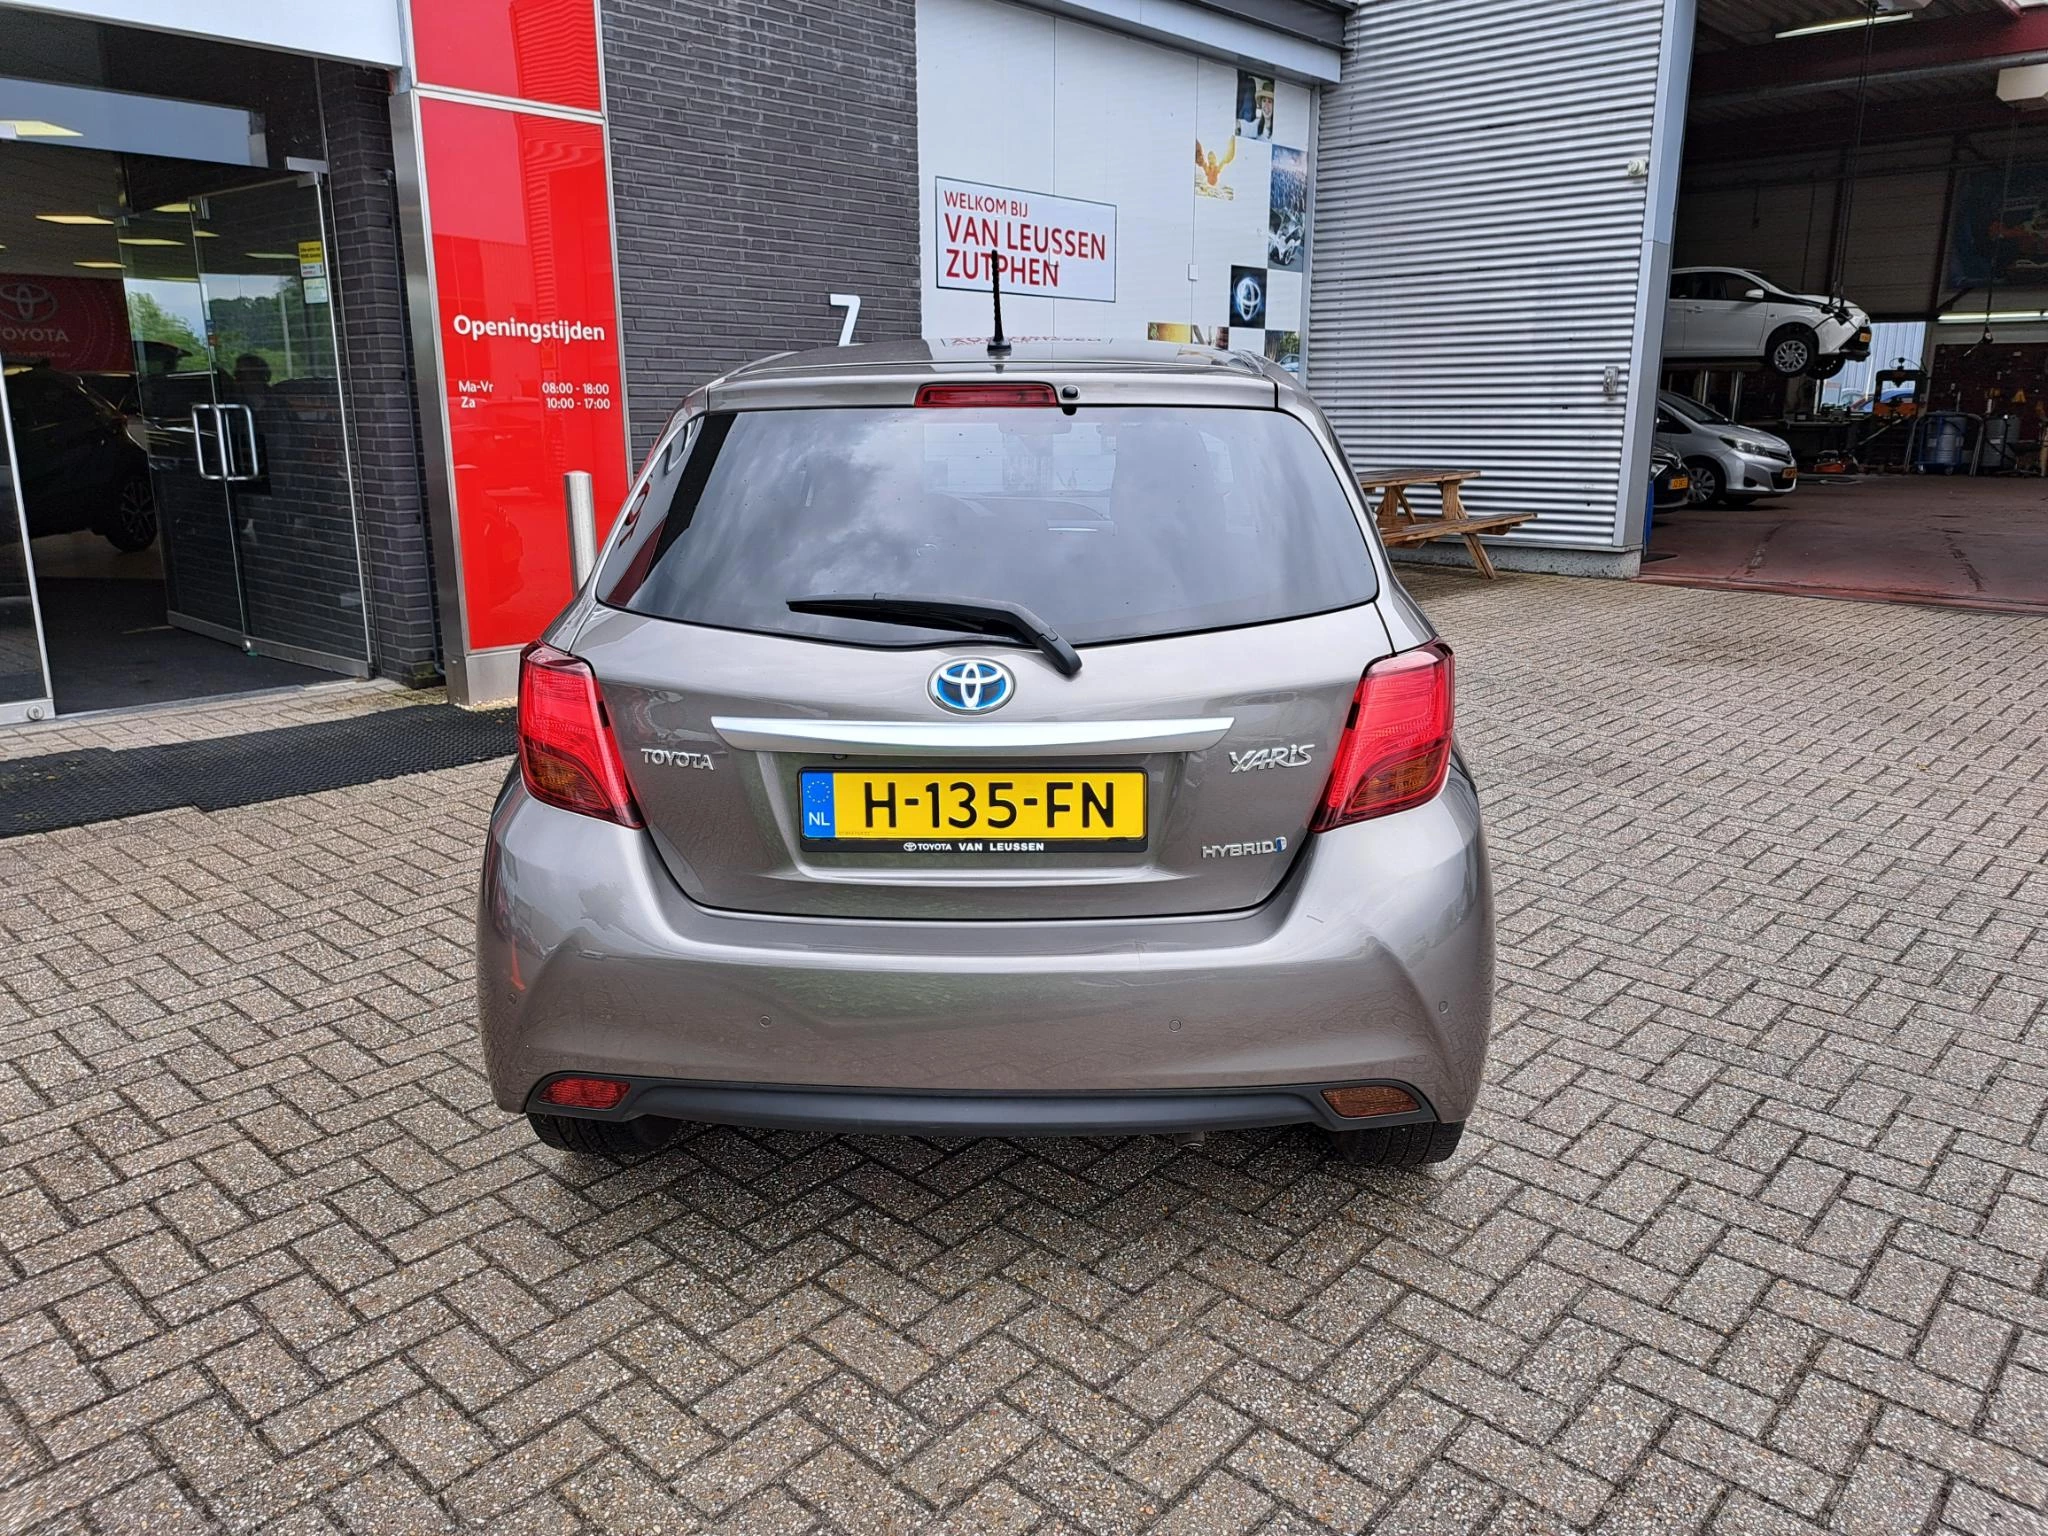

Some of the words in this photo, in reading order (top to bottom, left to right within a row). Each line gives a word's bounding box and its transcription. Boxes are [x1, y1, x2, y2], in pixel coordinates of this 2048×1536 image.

[944, 190, 1007, 215] WELKOM
[1010, 200, 1029, 218] BIJ
[944, 212, 999, 248] VAN
[1007, 221, 1106, 261] LEUSSEN
[946, 248, 1060, 288] ZUTPHEN
[453, 314, 606, 345] Openingstijden
[830, 293, 861, 347] 7
[0, 327, 71, 343] OYOTA
[458, 380, 495, 394] Ma-Vr
[541, 382, 574, 395] 08:00
[583, 383, 610, 396] 18:00
[460, 396, 476, 409] Za
[546, 397, 575, 410] 10:00
[584, 398, 611, 410] 17:00
[640, 747, 715, 772] TOYOTA
[863, 781, 1115, 829] H-135-FN
[808, 811, 831, 828] NL
[917, 843, 952, 852] TOYOTA
[958, 842, 984, 852] VAN
[989, 842, 1045, 852] LEUSSEN
[1201, 840, 1275, 859] HYBRID
